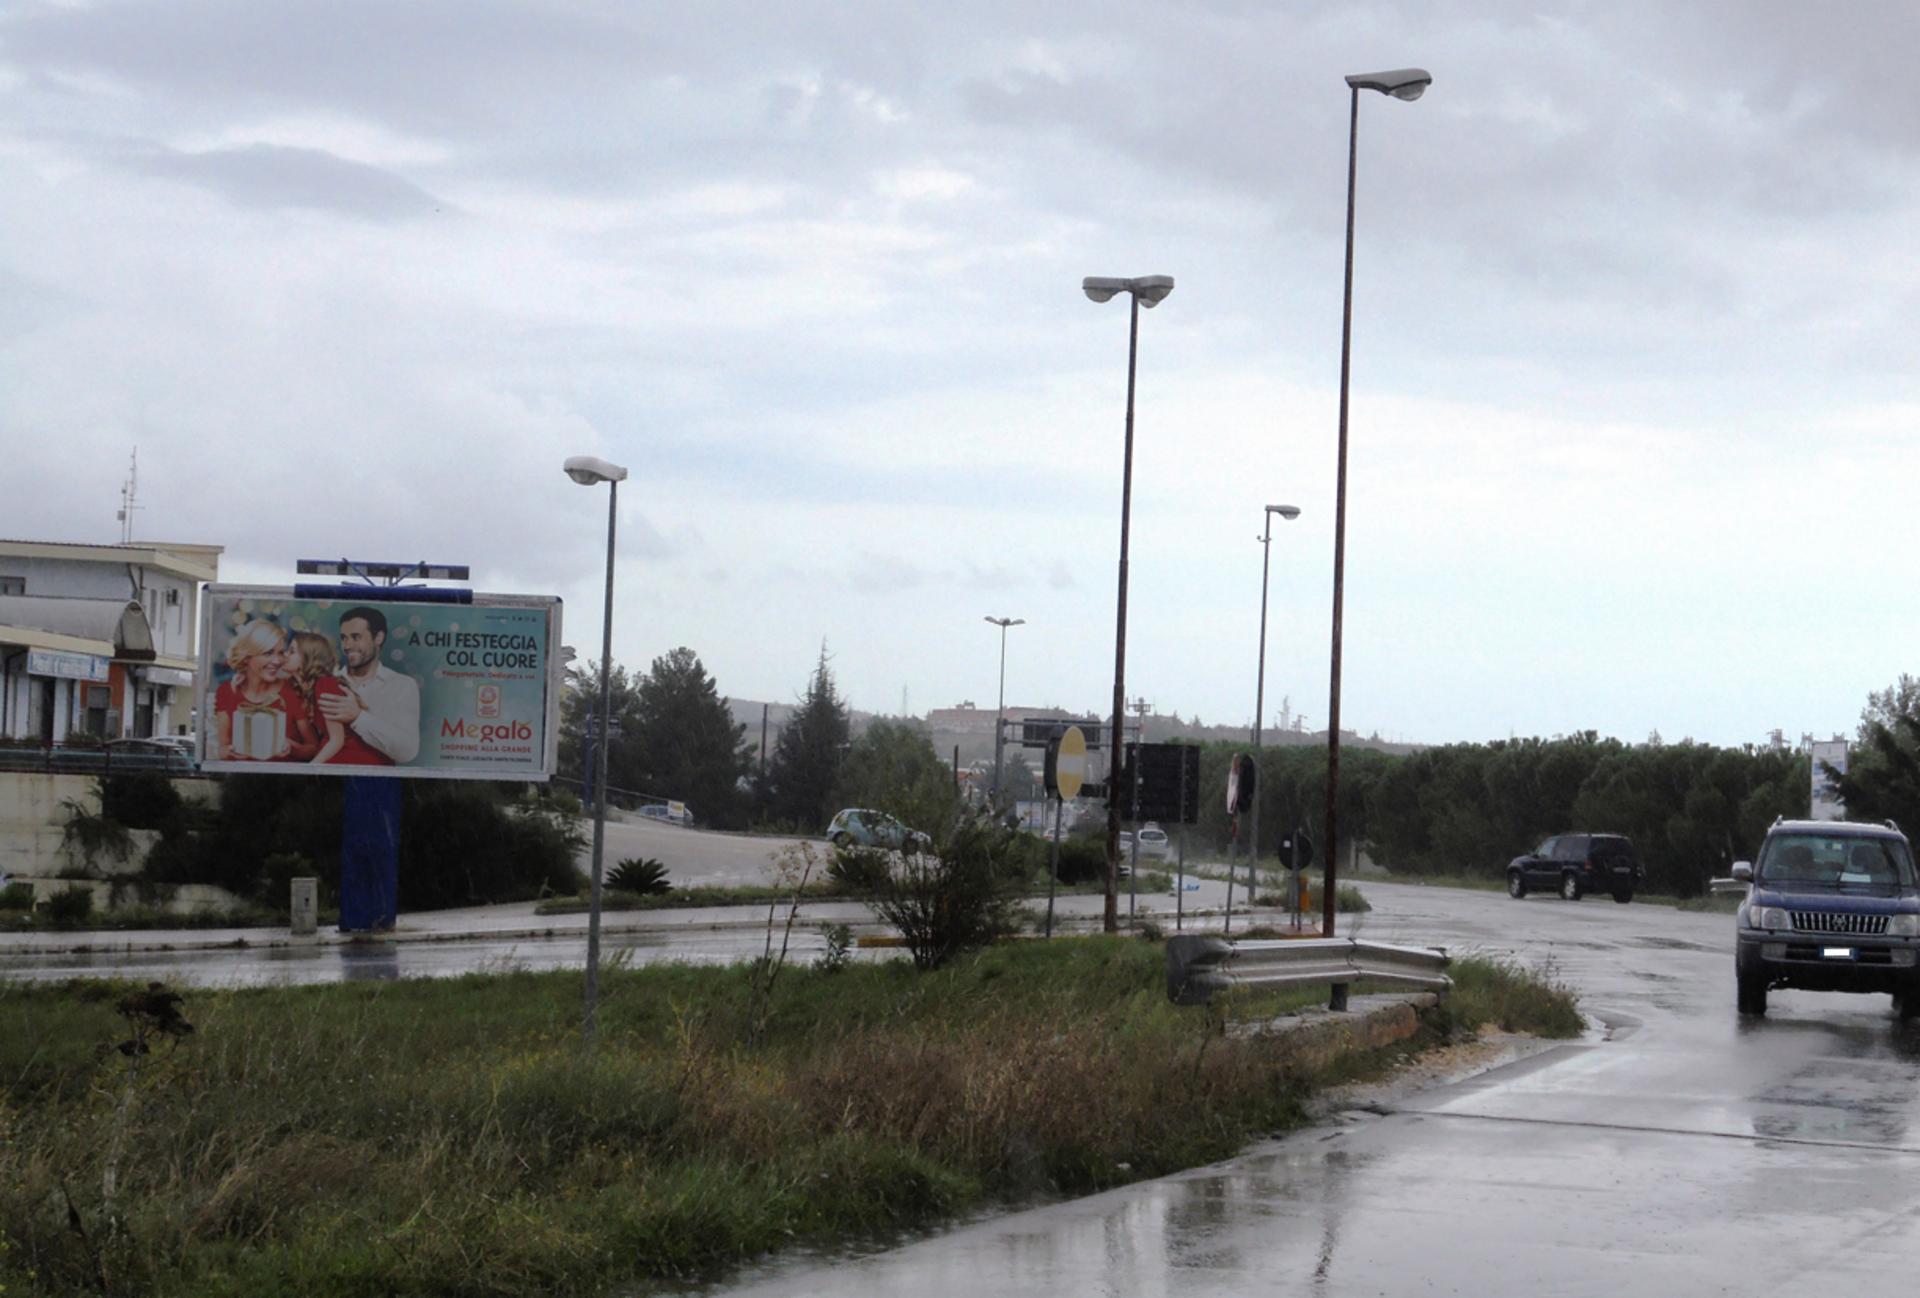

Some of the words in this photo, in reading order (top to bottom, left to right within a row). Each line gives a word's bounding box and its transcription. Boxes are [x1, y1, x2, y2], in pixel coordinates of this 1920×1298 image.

[408, 631, 420, 646] A
[424, 631, 451, 647] CHI
[455, 632, 537, 650] FESTEGGIA
[446, 651, 478, 667] COL
[482, 652, 537, 668] CUORE
[440, 743, 479, 752] SHOPPING
[480, 744, 499, 753] ALLA
[501, 745, 532, 754] GRANDE
